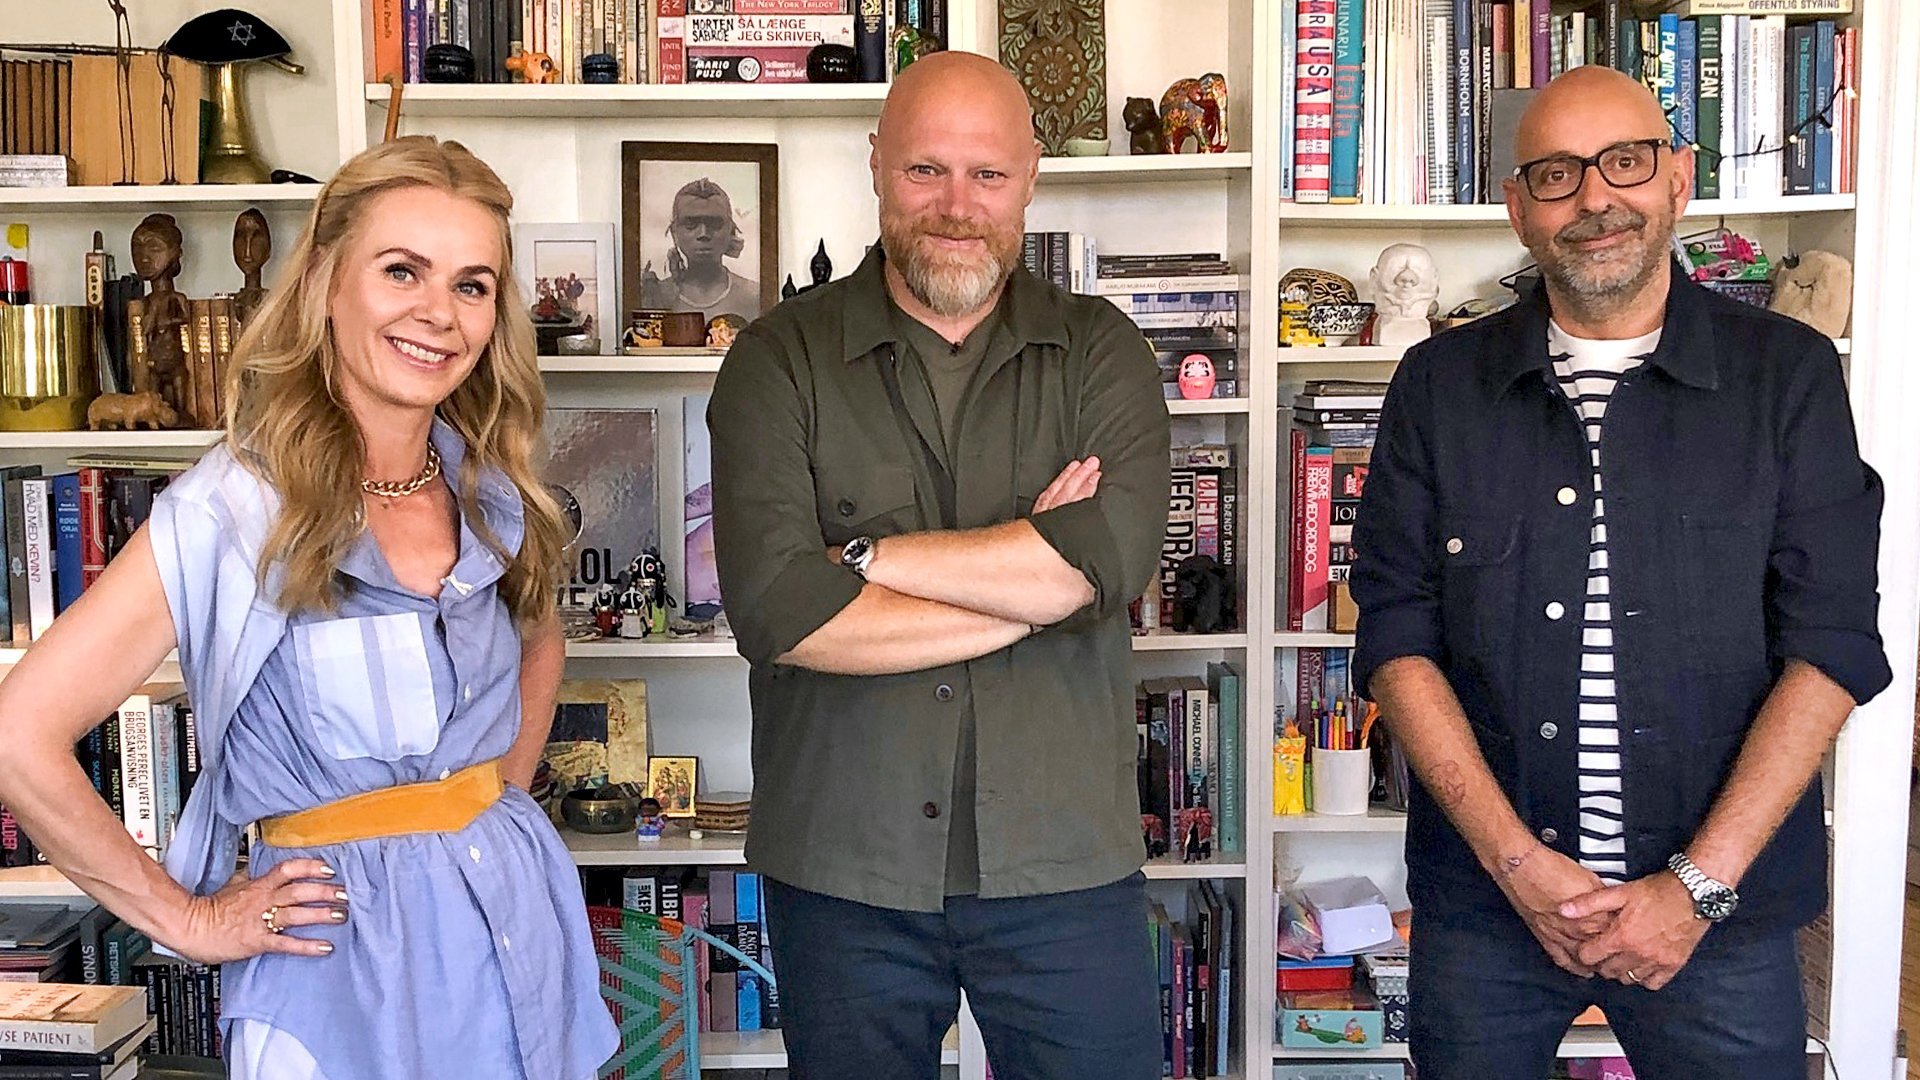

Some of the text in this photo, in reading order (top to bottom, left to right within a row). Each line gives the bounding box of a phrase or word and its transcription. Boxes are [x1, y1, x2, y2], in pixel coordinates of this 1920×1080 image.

[737, 31, 763, 42] JEG
[758, 18, 807, 30] LÆNGE
[695, 60, 730, 70] MARIO
[1459, 48, 1471, 117] BORNHOLM
[1700, 57, 1719, 99] LEAN
[1681, 82, 1692, 145] ENGAGEM
[1052, 233, 1064, 272] HARUKI
[1317, 466, 1329, 500] STORE
[25, 483, 41, 584] HVAD MED KEVIN?
[1223, 494, 1235, 566] BRÆNDT BARN
[1191, 699, 1203, 735] MICHAEL
[124, 711, 138, 789] BRUGSANVISNING
[135, 711, 150, 820] GEORGES PEREC LIVET EN
[23, 1031, 72, 1045] PATIENT
